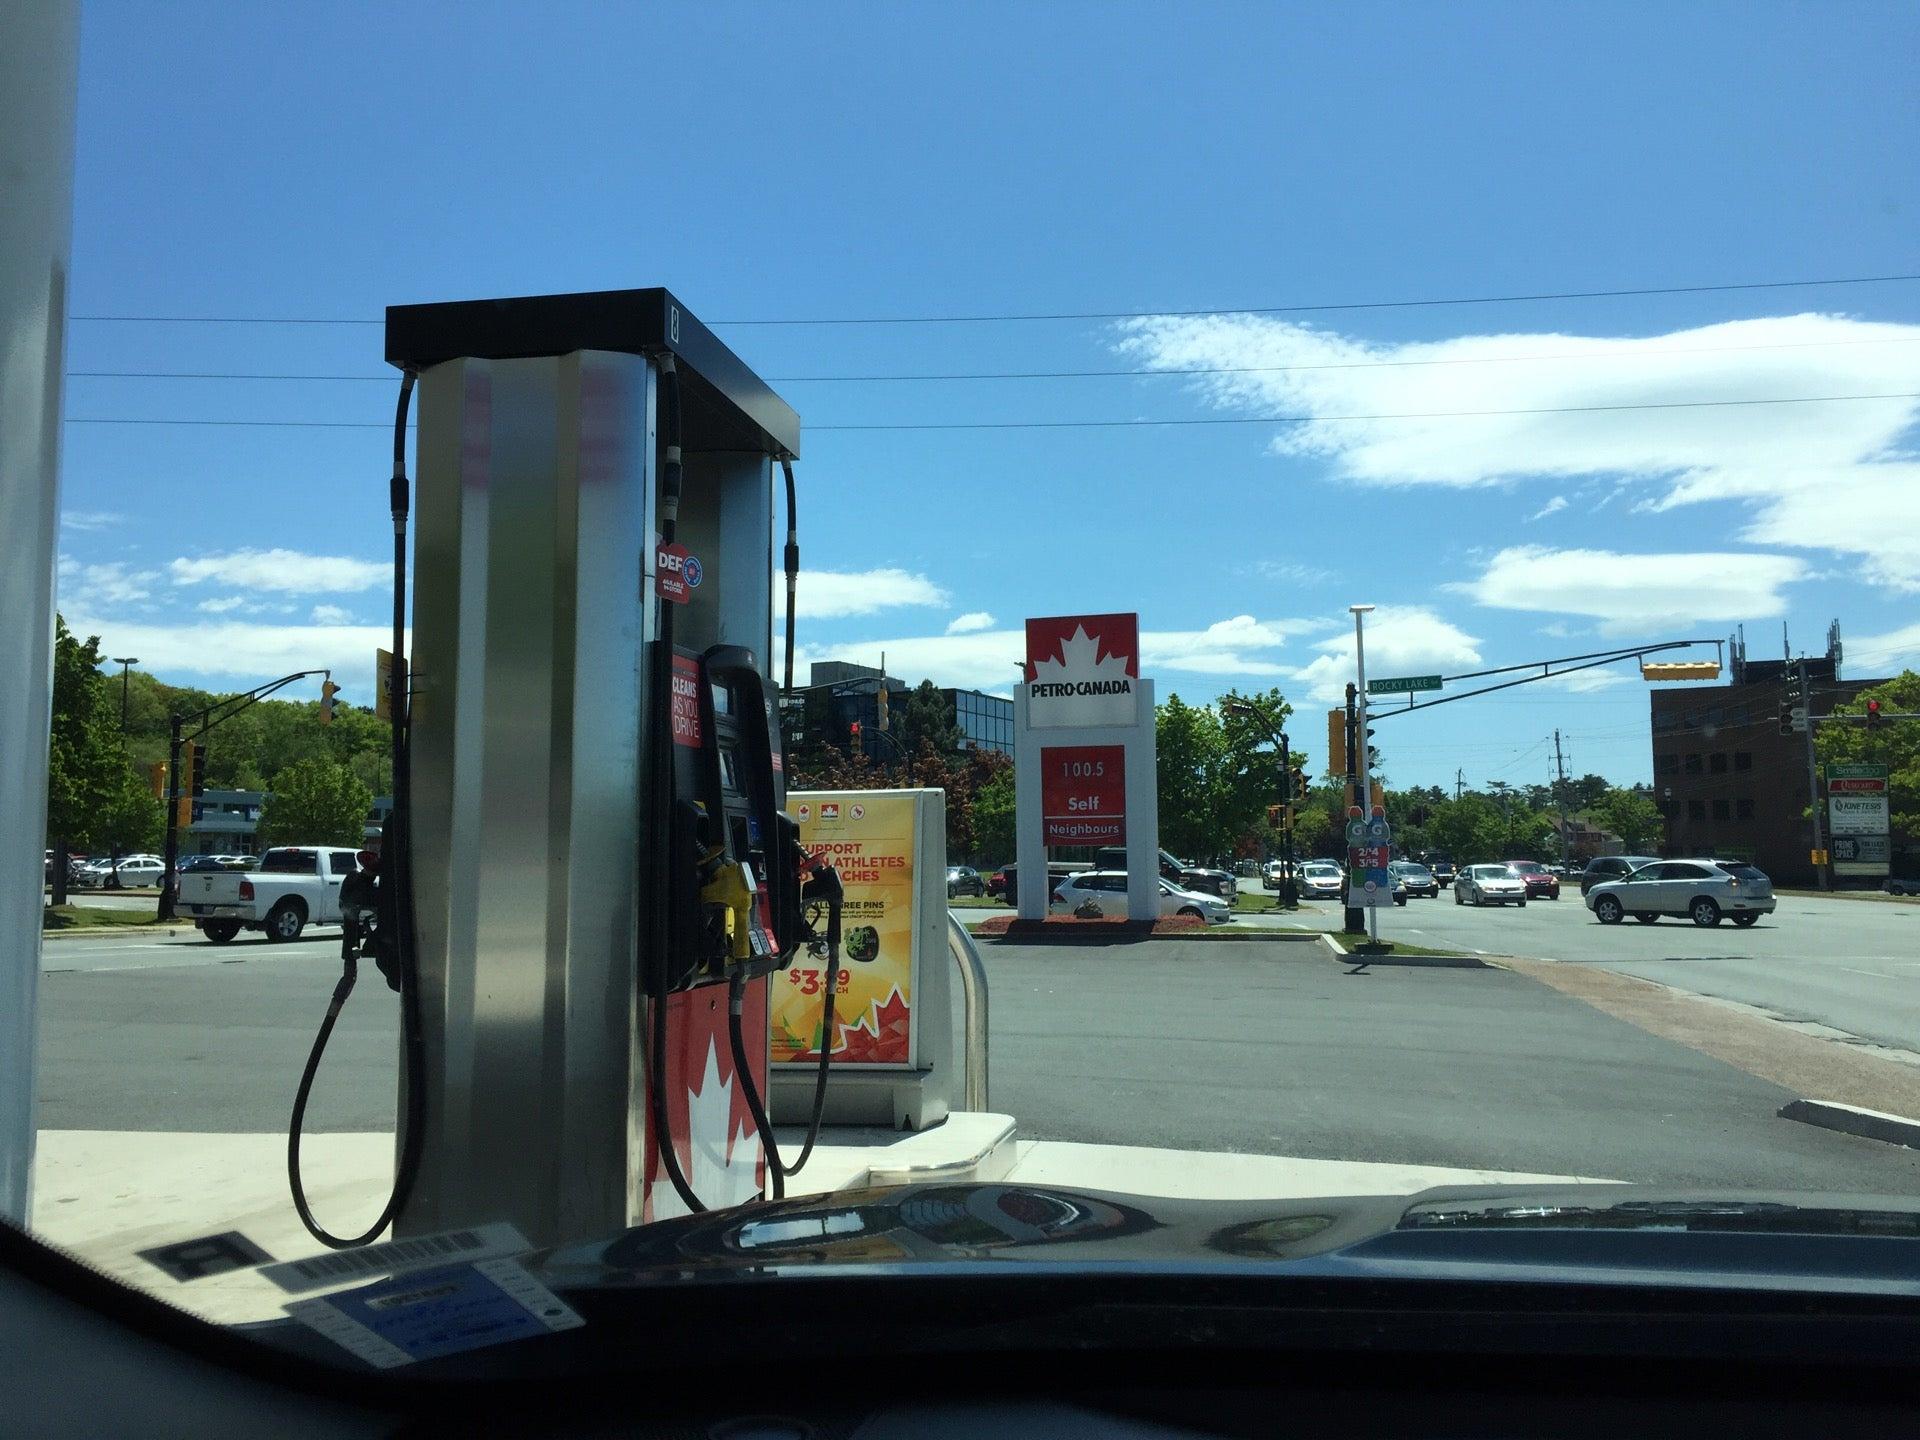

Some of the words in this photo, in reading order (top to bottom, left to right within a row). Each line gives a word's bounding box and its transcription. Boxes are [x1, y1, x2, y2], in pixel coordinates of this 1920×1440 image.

[658, 552, 683, 571] DEF
[672, 676, 697, 698] CLEANS
[1372, 682, 1402, 691] ROCKY
[1406, 679, 1428, 689] LAKE
[673, 696, 683, 714] AS
[684, 699, 698, 718] YOU
[674, 716, 699, 738] DRIVE
[1063, 761, 1104, 777] 100.5
[1068, 796, 1100, 811] Self
[1049, 824, 1119, 836] Neighbours
[834, 857, 905, 868] ATHLETES
[789, 968, 850, 995] $3.9
